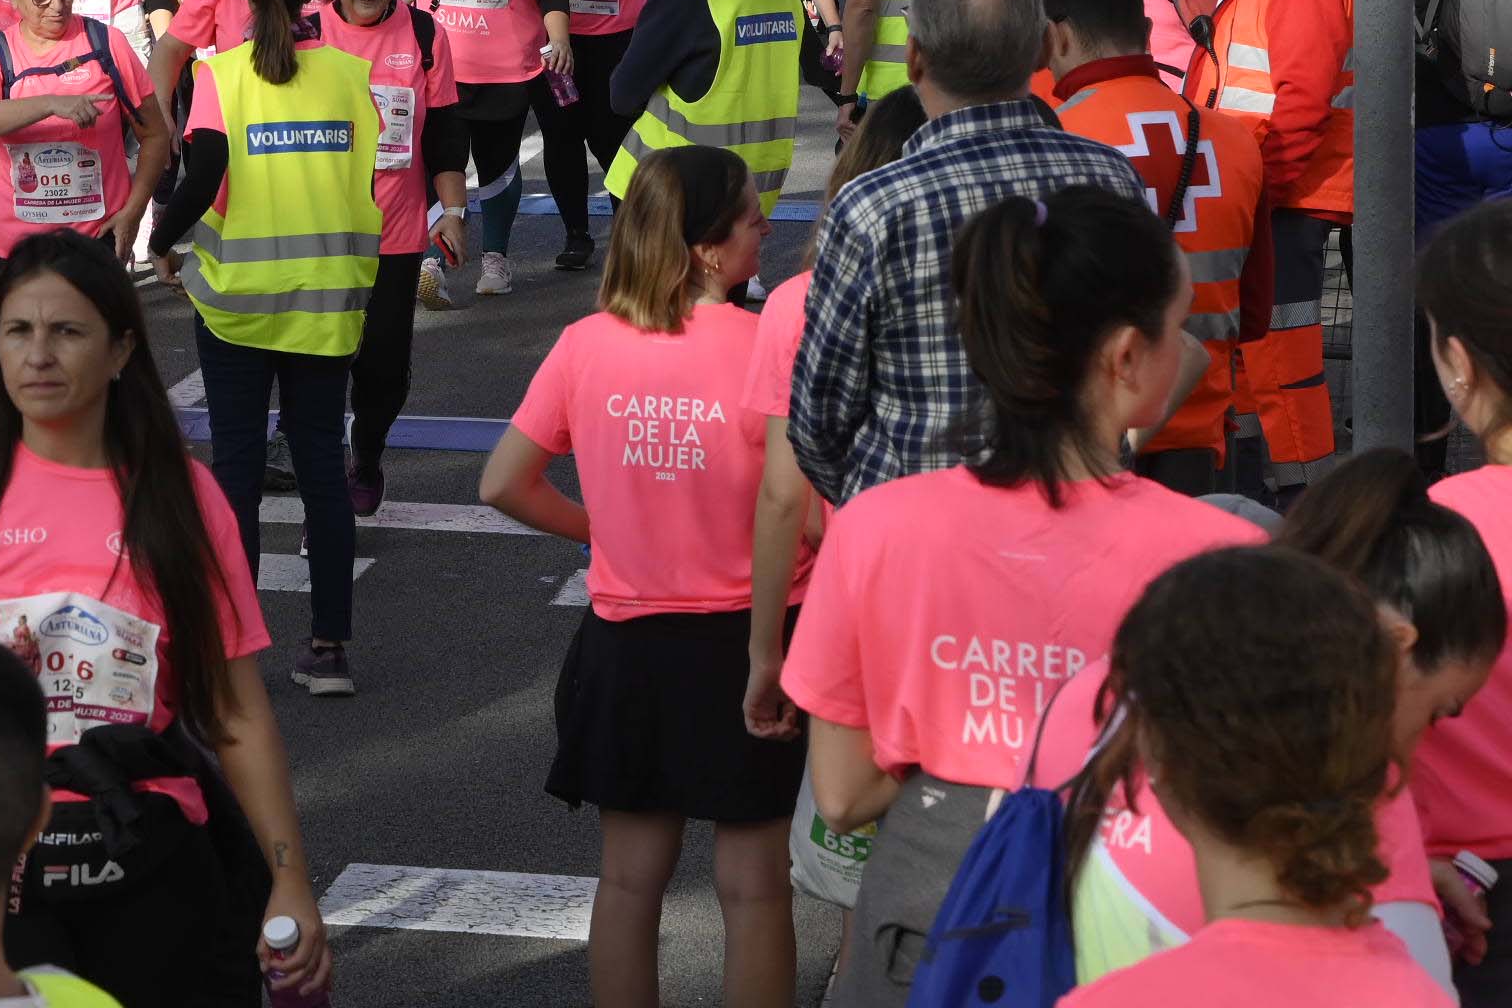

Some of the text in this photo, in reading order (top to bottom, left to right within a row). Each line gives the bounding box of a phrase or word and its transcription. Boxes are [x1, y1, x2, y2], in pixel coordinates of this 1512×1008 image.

[436, 8, 489, 30] SUMA
[737, 18, 797, 42] VOLUNTARIS
[249, 128, 349, 147] VOLUNTARIS
[40, 173, 72, 187] 016
[44, 189, 69, 197] 23022
[21, 211, 48, 219] OYSHO
[69, 207, 98, 217] Santander
[606, 394, 726, 424] CARRERA
[628, 420, 701, 446] DE LA
[622, 445, 706, 472] MUJER
[654, 471, 676, 481] 2023
[46, 619, 104, 642] ASTURIANA
[969, 672, 1018, 713] DE
[57, 699, 72, 709] DE
[109, 711, 135, 722] 2023
[43, 859, 125, 887] FILA
